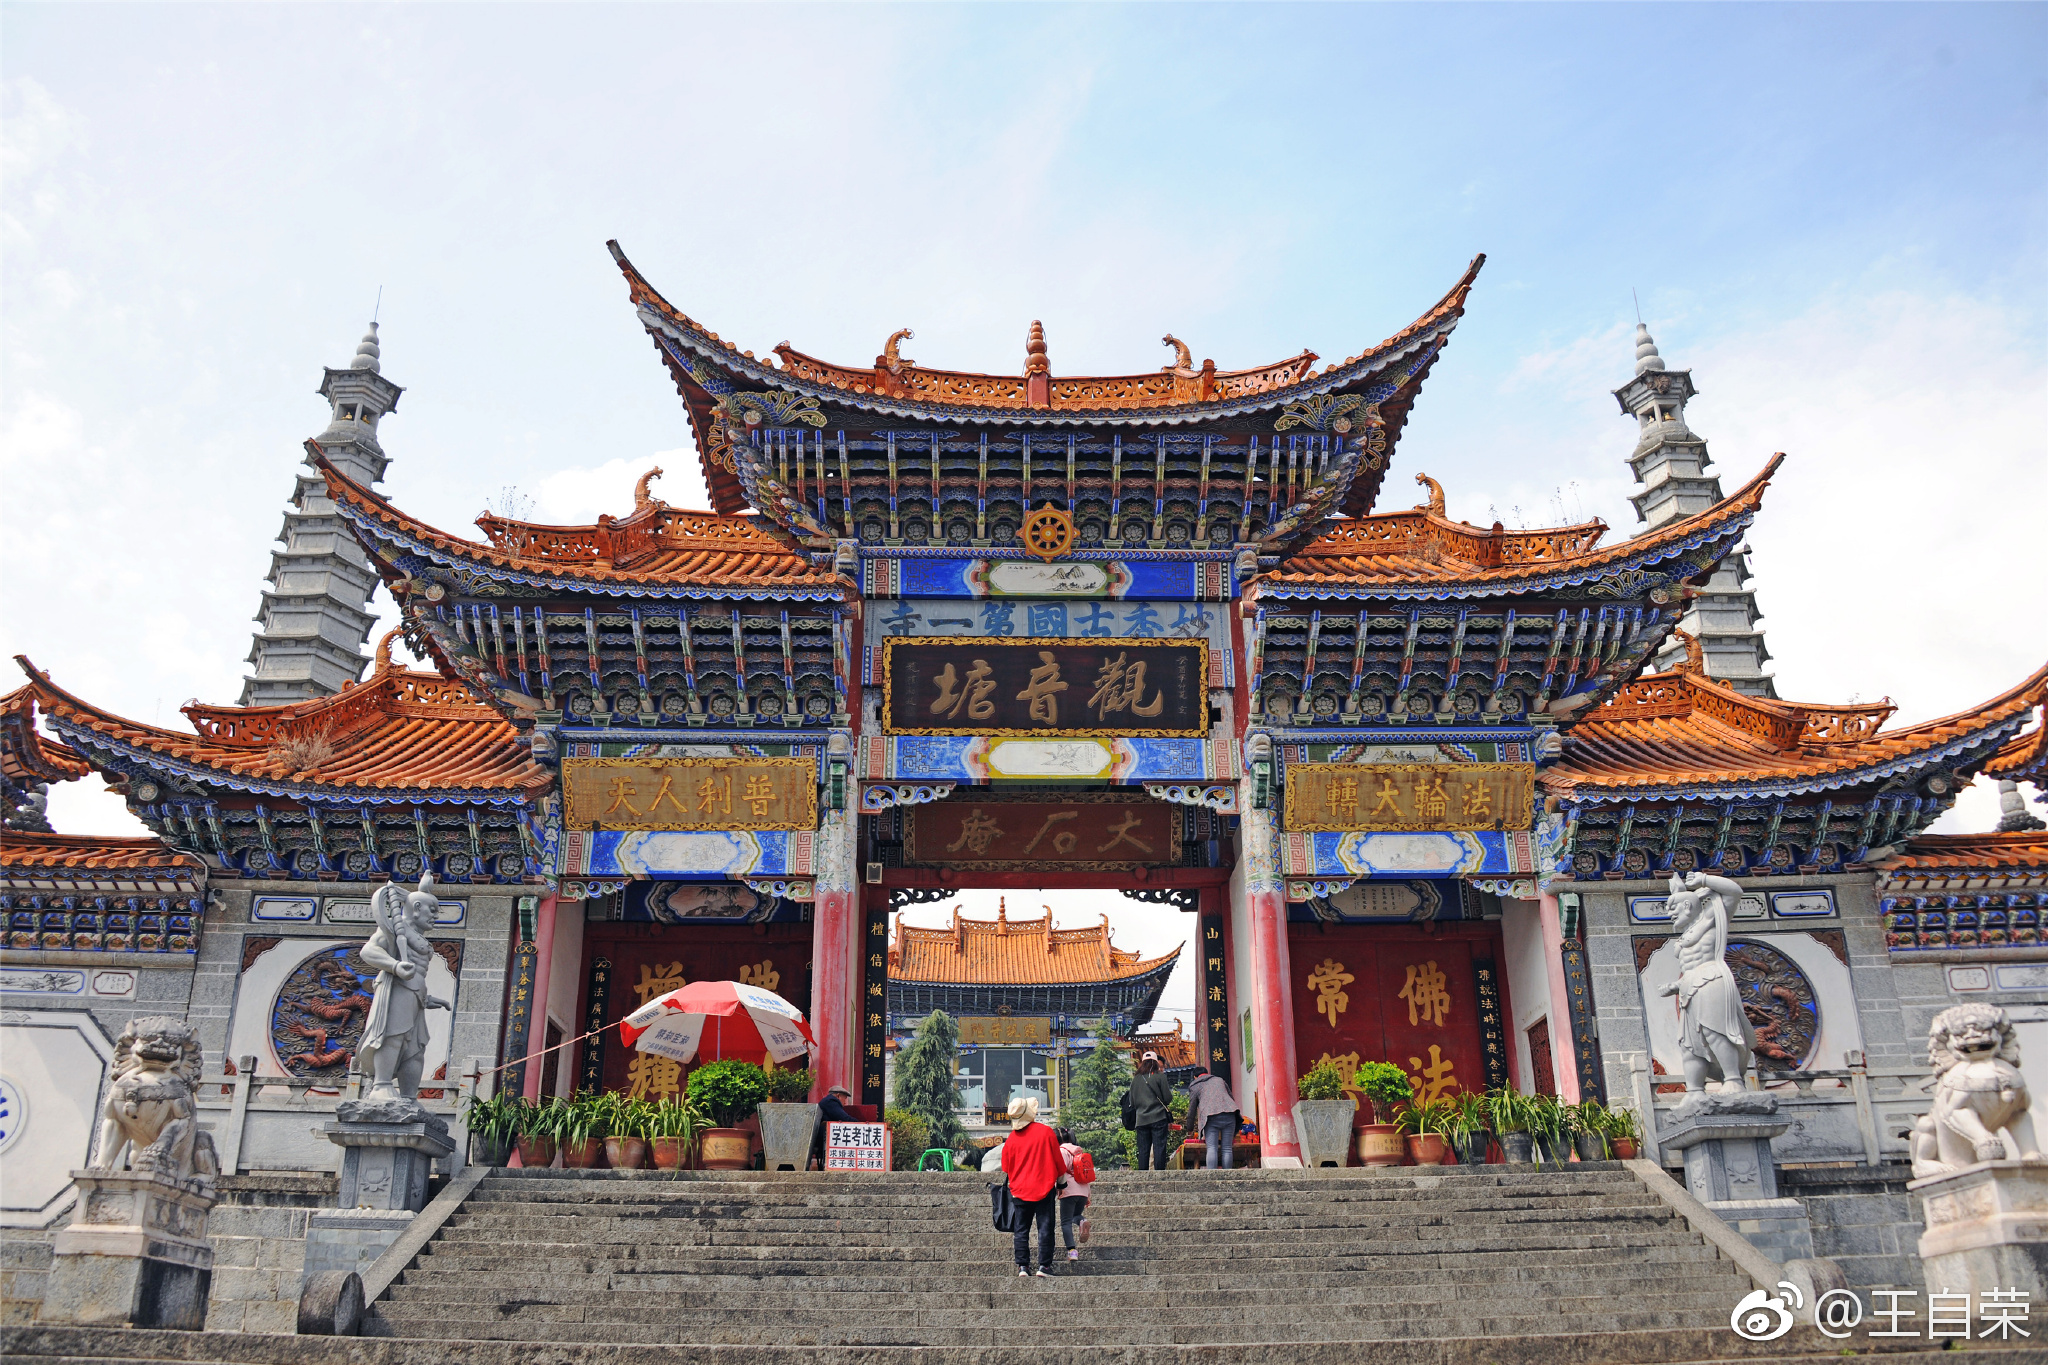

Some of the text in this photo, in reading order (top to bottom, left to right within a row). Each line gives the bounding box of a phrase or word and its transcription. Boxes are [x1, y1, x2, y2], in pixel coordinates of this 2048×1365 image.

[880, 600, 1214, 637] 妙香古國第一寺
[930, 651, 1162, 725] 觀音塘
[604, 774, 777, 816] 普利人天
[1325, 778, 1492, 817] 法輪大轉
[947, 809, 1153, 856] 大石庵
[867, 922, 885, 1124] 檀信皈依增福
[829, 1150, 855, 1158] 求婚表
[832, 1126, 882, 1146] 学车考试表
[858, 1150, 883, 1159] 平安表
[829, 1160, 855, 1168] 求子表
[858, 1160, 883, 1169] 求财表
